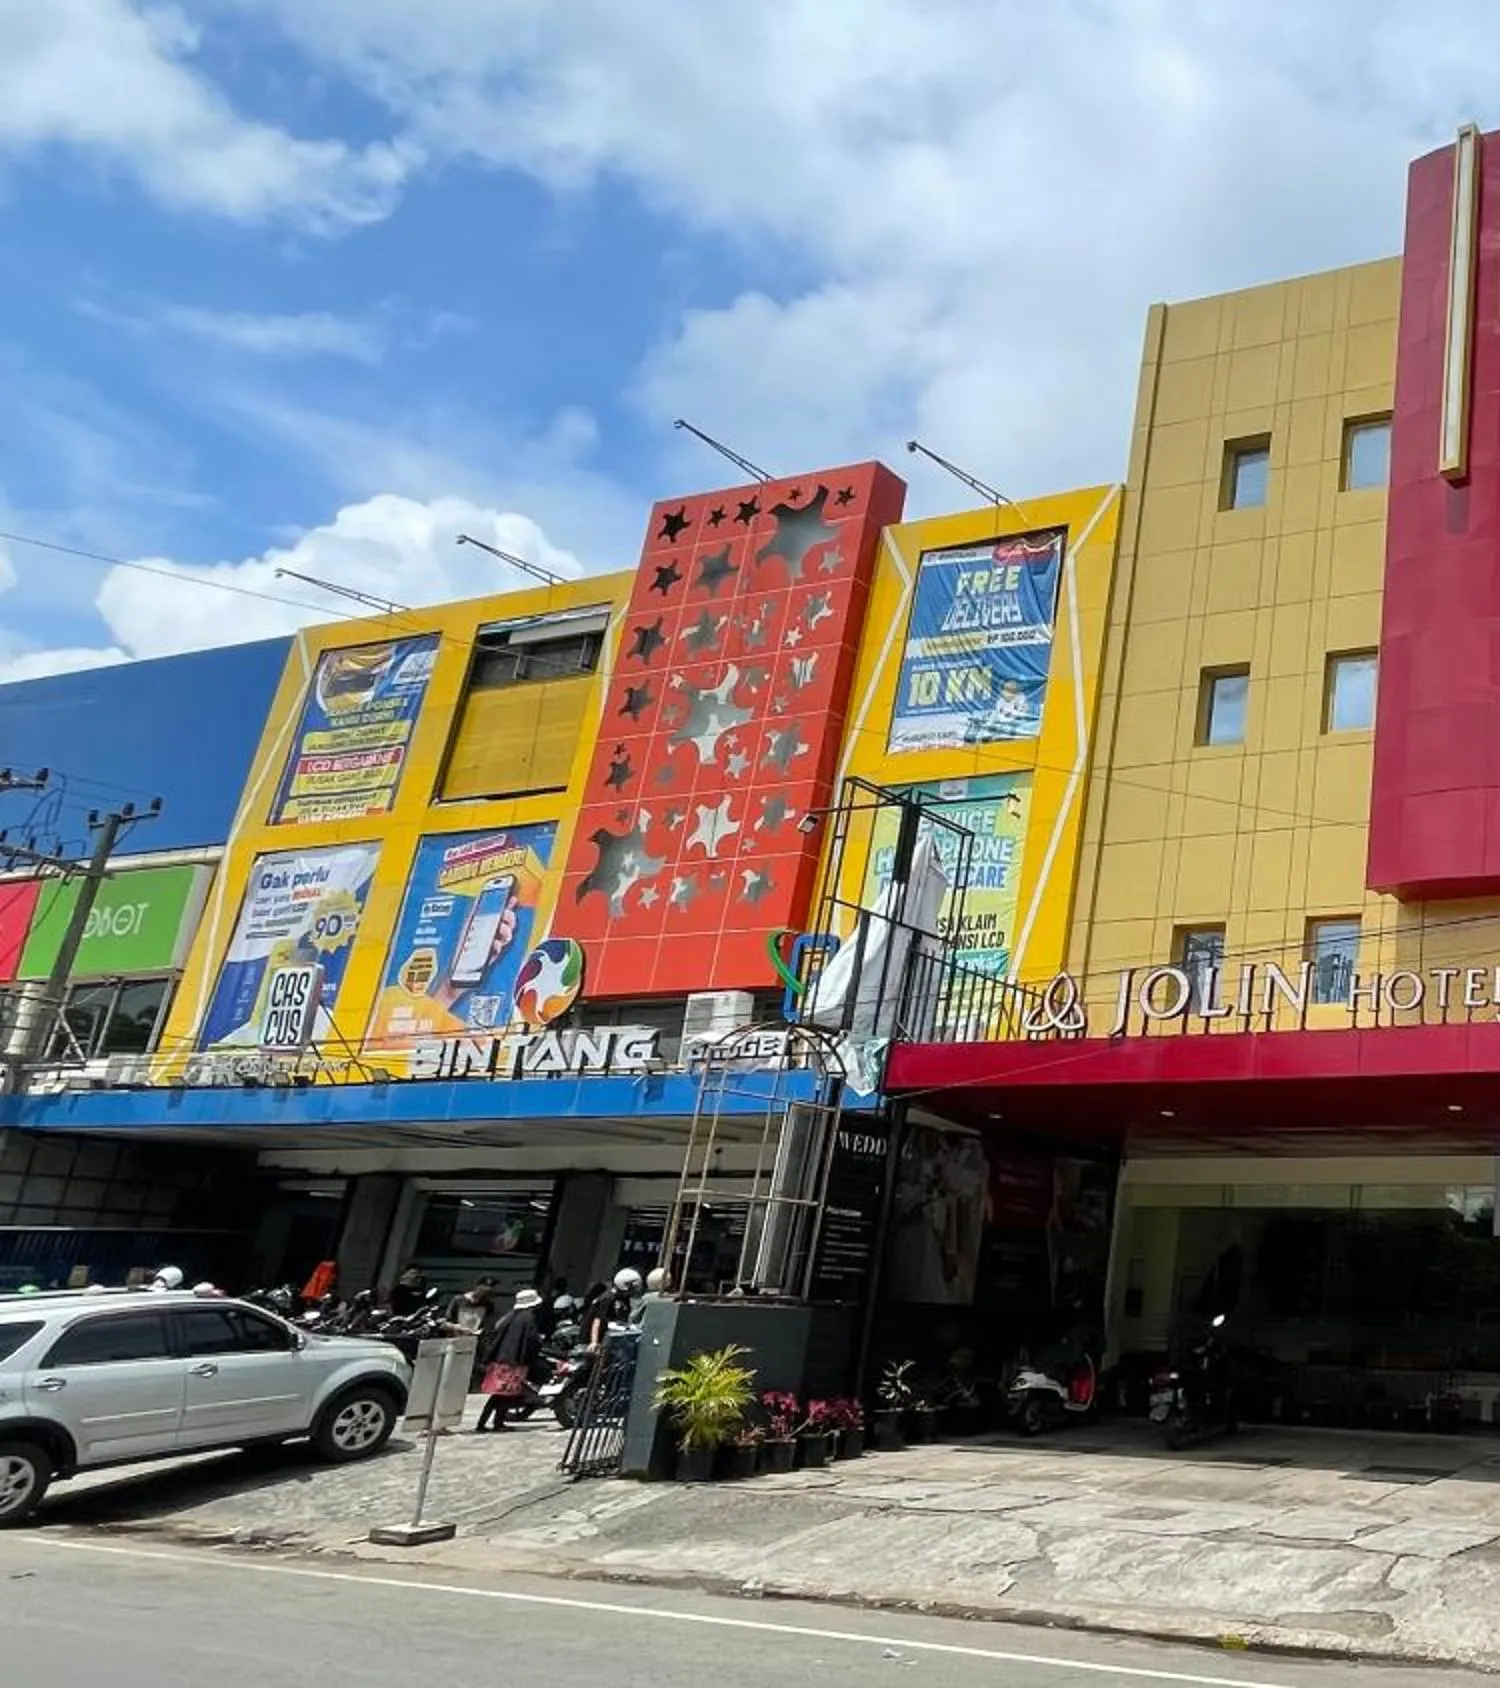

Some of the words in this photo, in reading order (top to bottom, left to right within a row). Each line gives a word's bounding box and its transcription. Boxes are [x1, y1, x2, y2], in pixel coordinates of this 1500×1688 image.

[956, 565, 1022, 598] FREE
[941, 592, 1023, 631] DELIVERY
[908, 671, 941, 707] 10
[945, 664, 993, 704] KM
[260, 871, 291, 889] Gak
[291, 866, 330, 888] perlu
[314, 914, 343, 940] 90
[981, 931, 1005, 949] LCD
[271, 972, 310, 1008] CAS
[1108, 960, 1314, 1038] JOLIN
[263, 1009, 301, 1046] CUS
[411, 1026, 660, 1078] BINTANG
